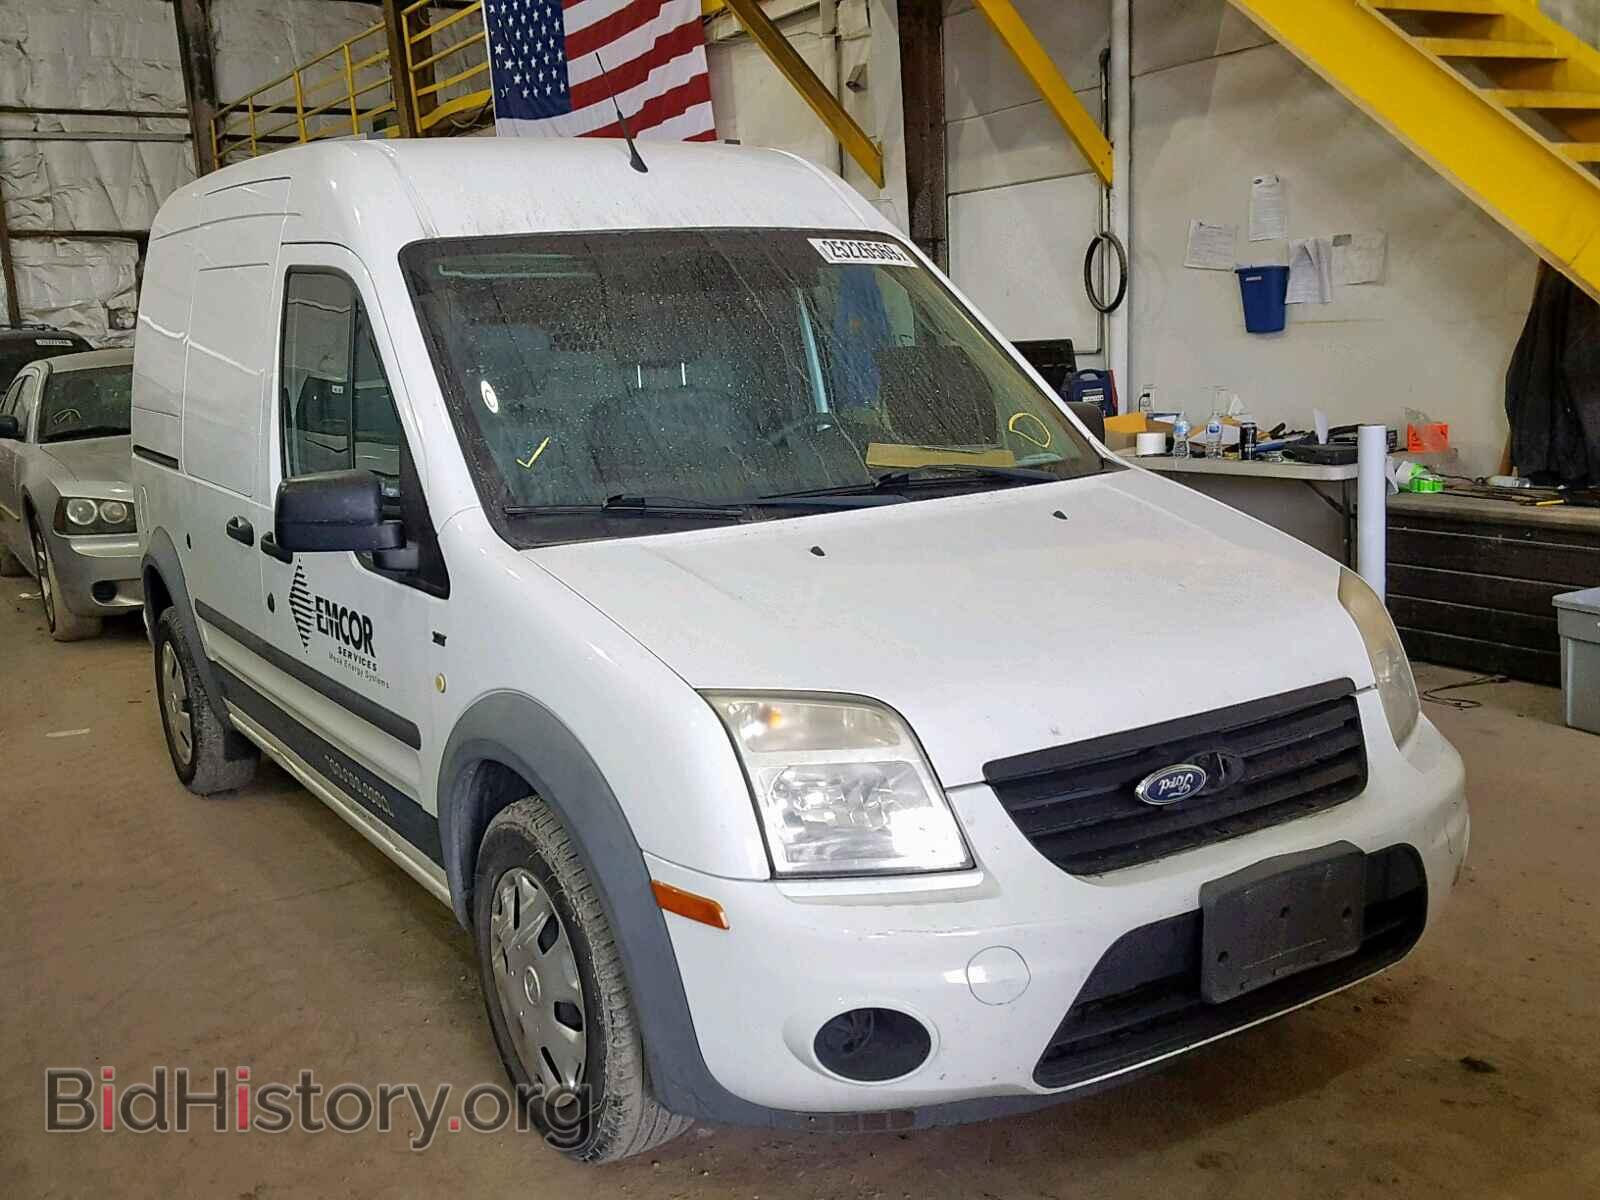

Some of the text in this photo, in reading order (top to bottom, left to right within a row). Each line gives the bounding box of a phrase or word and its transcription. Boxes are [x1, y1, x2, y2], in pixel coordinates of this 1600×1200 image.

[315, 595, 376, 658] EMCOR
[338, 646, 378, 672] SERVICES
[344, 661, 364, 678] Energy
[365, 671, 390, 689] Systems
[1158, 773, 1194, 798] Ford
